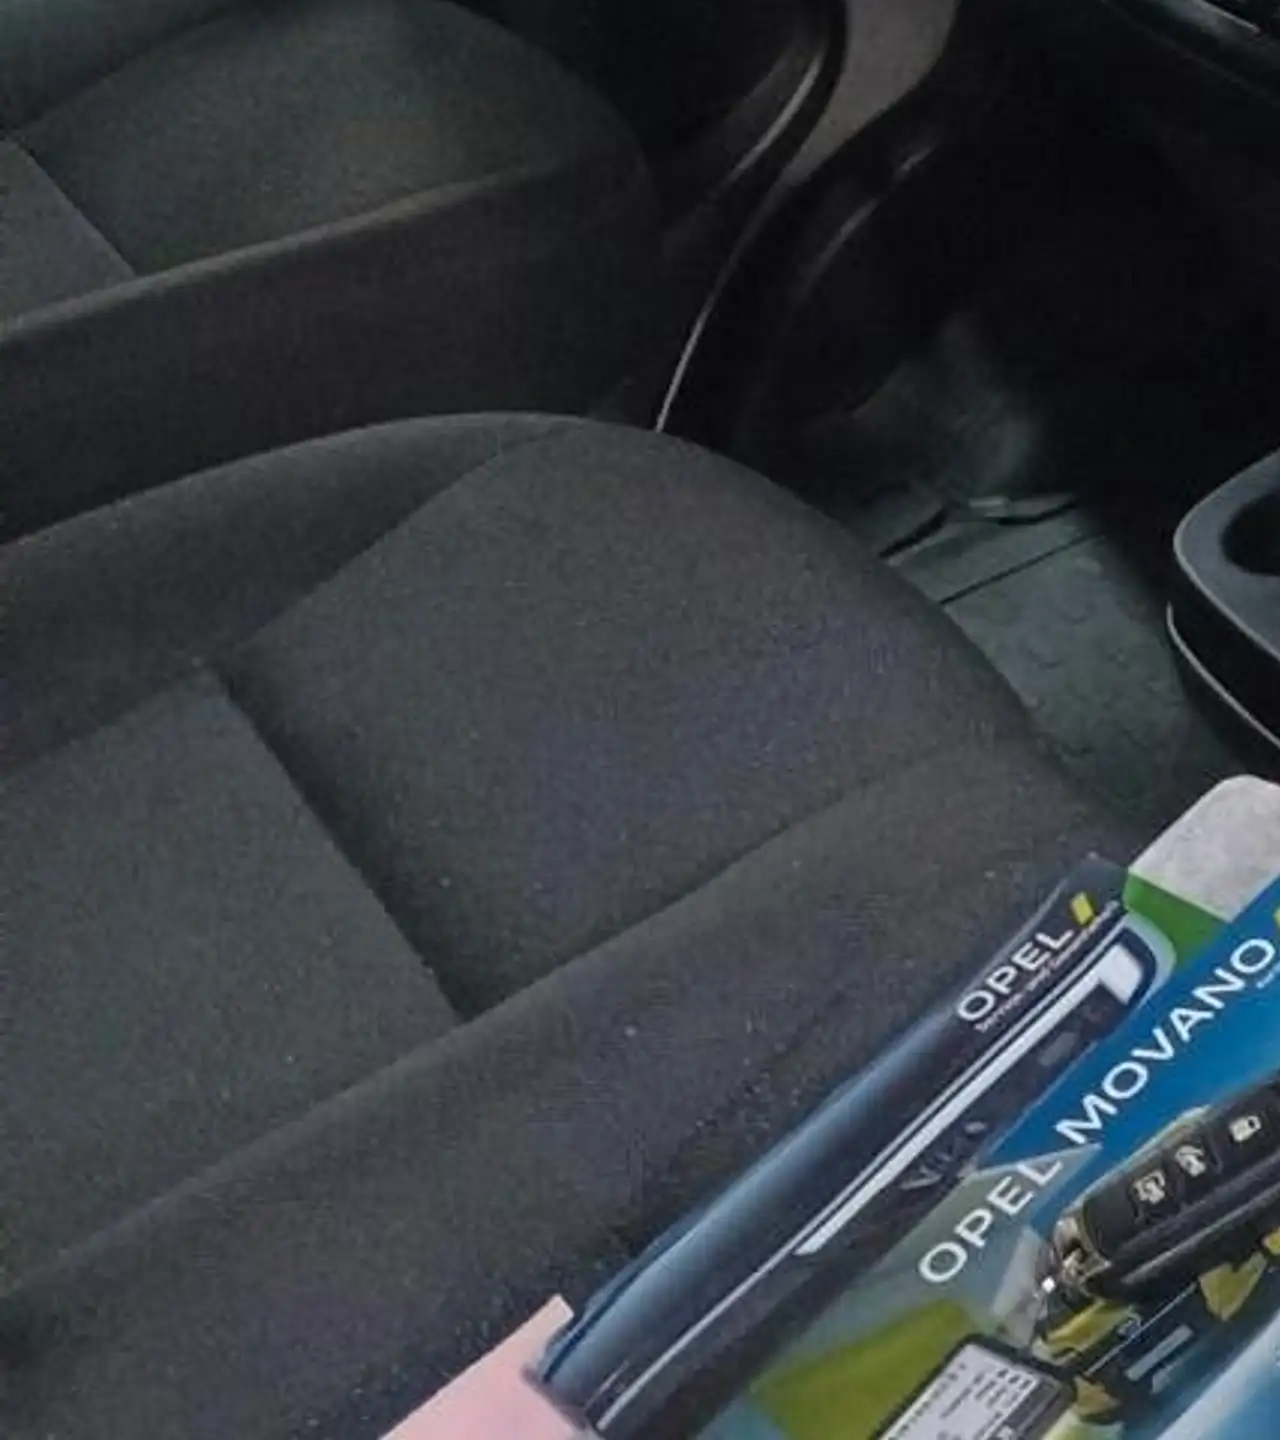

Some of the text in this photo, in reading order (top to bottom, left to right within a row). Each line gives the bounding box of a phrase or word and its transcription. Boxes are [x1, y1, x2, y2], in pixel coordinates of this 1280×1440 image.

[956, 929, 1074, 1021] OPEL
[916, 1159, 1065, 1283] OPEL
[1054, 937, 1277, 1145] MOVANO
